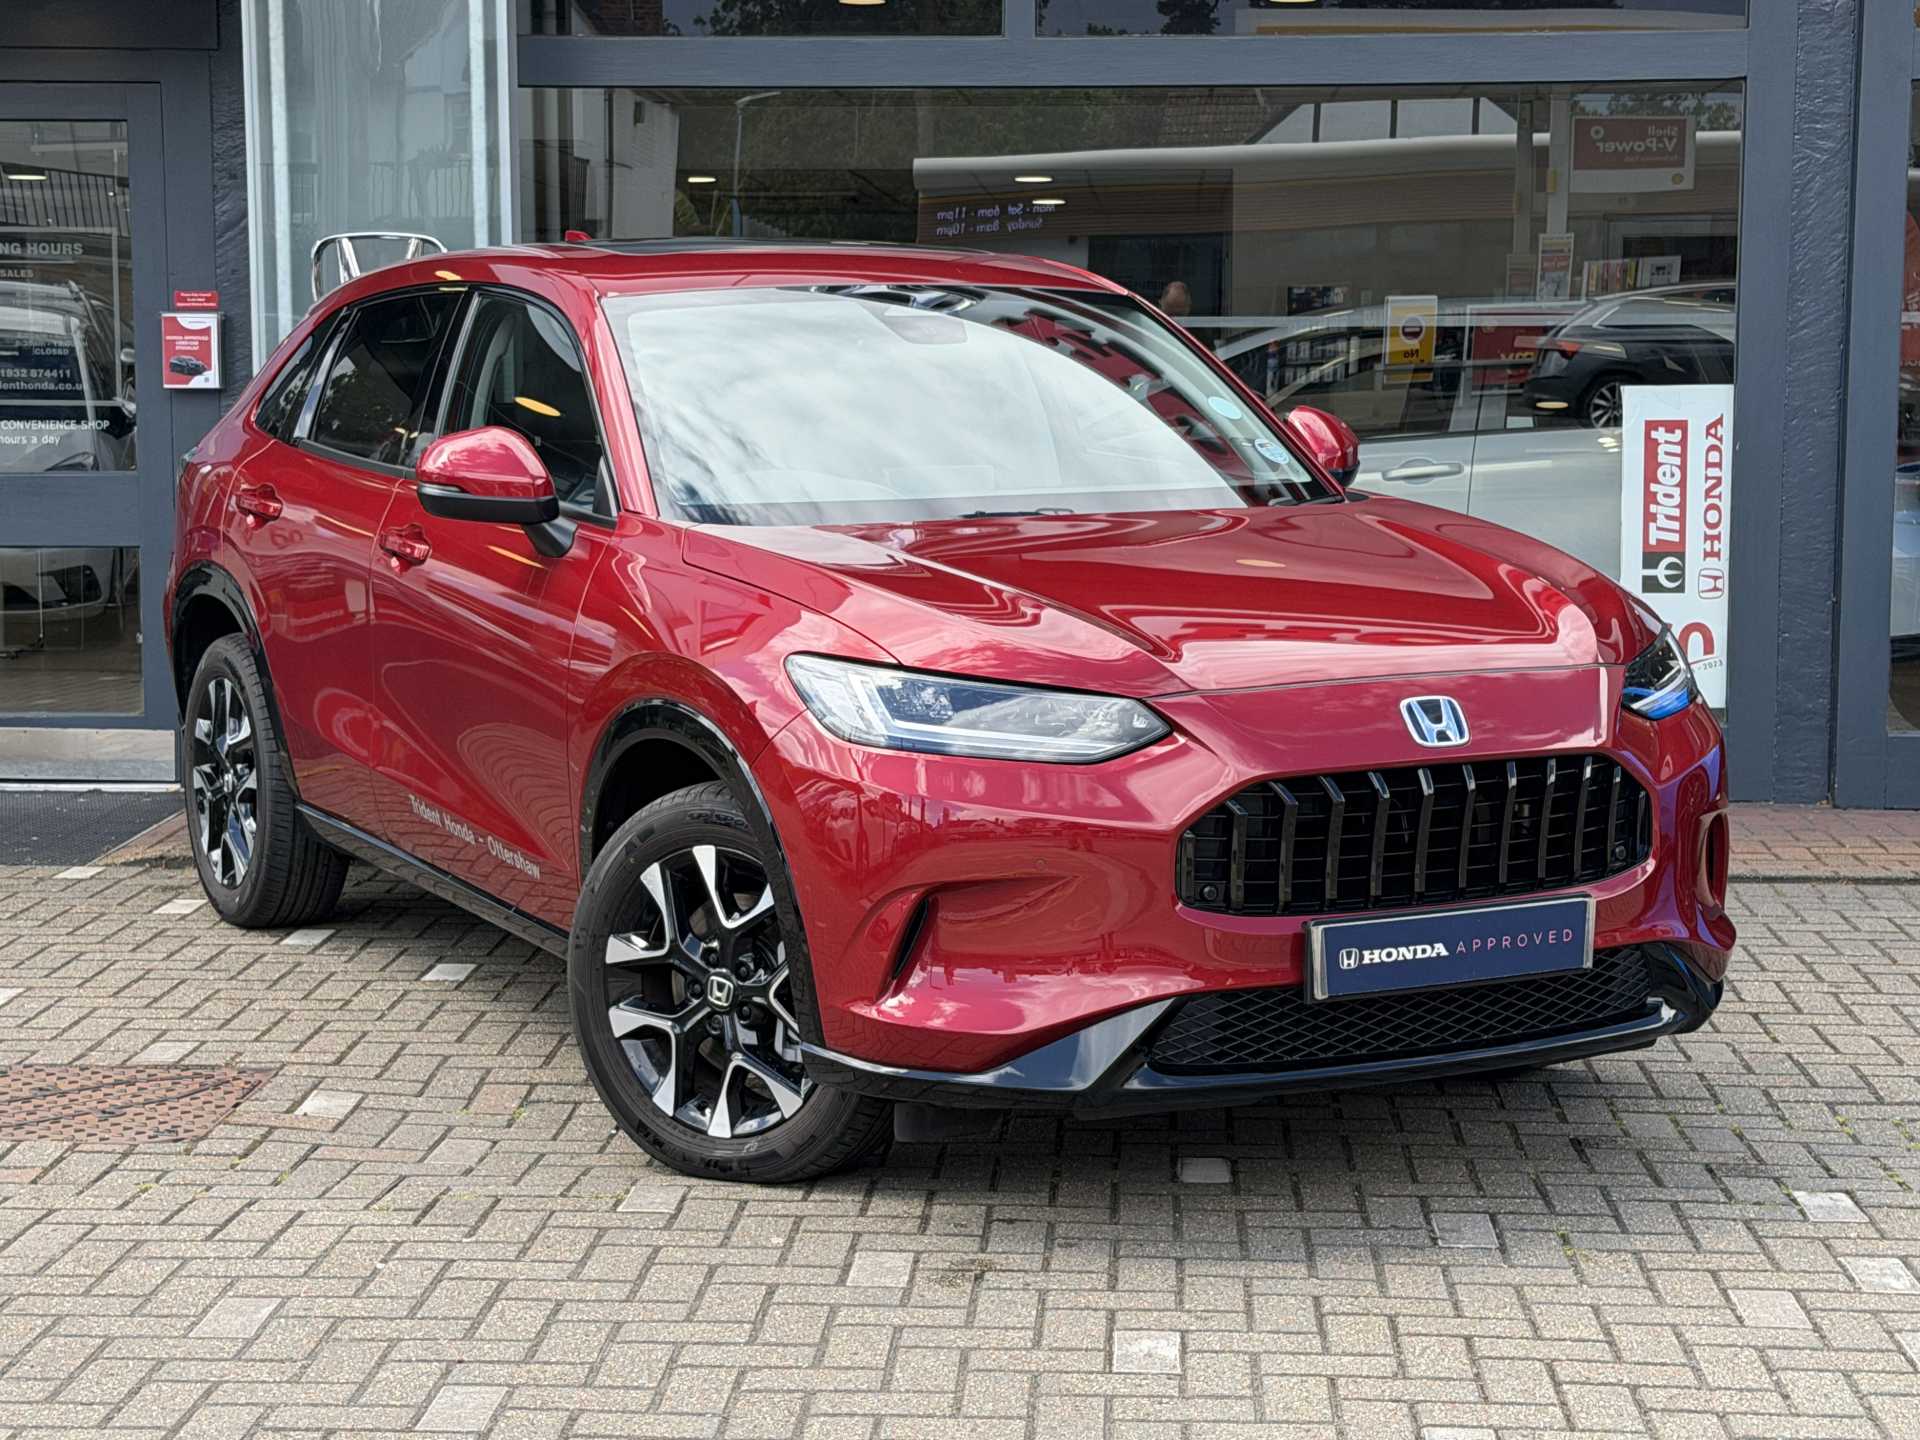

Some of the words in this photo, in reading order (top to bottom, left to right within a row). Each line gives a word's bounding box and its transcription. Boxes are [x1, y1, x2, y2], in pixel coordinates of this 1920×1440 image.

[27, 242, 83, 255] HOURS
[0, 268, 34, 278] SALES
[1, 419, 76, 430] CONVENIENCE
[81, 419, 110, 430] SHOP
[42, 434, 60, 446] day
[1649, 426, 1683, 546] Trident
[1703, 413, 1724, 562] HONDA
[408, 794, 442, 828] Trident
[443, 812, 476, 845] Honda
[487, 835, 540, 880] Ottershaw
[1361, 942, 1449, 965] HONDA
[1456, 928, 1573, 954] APPROVED
